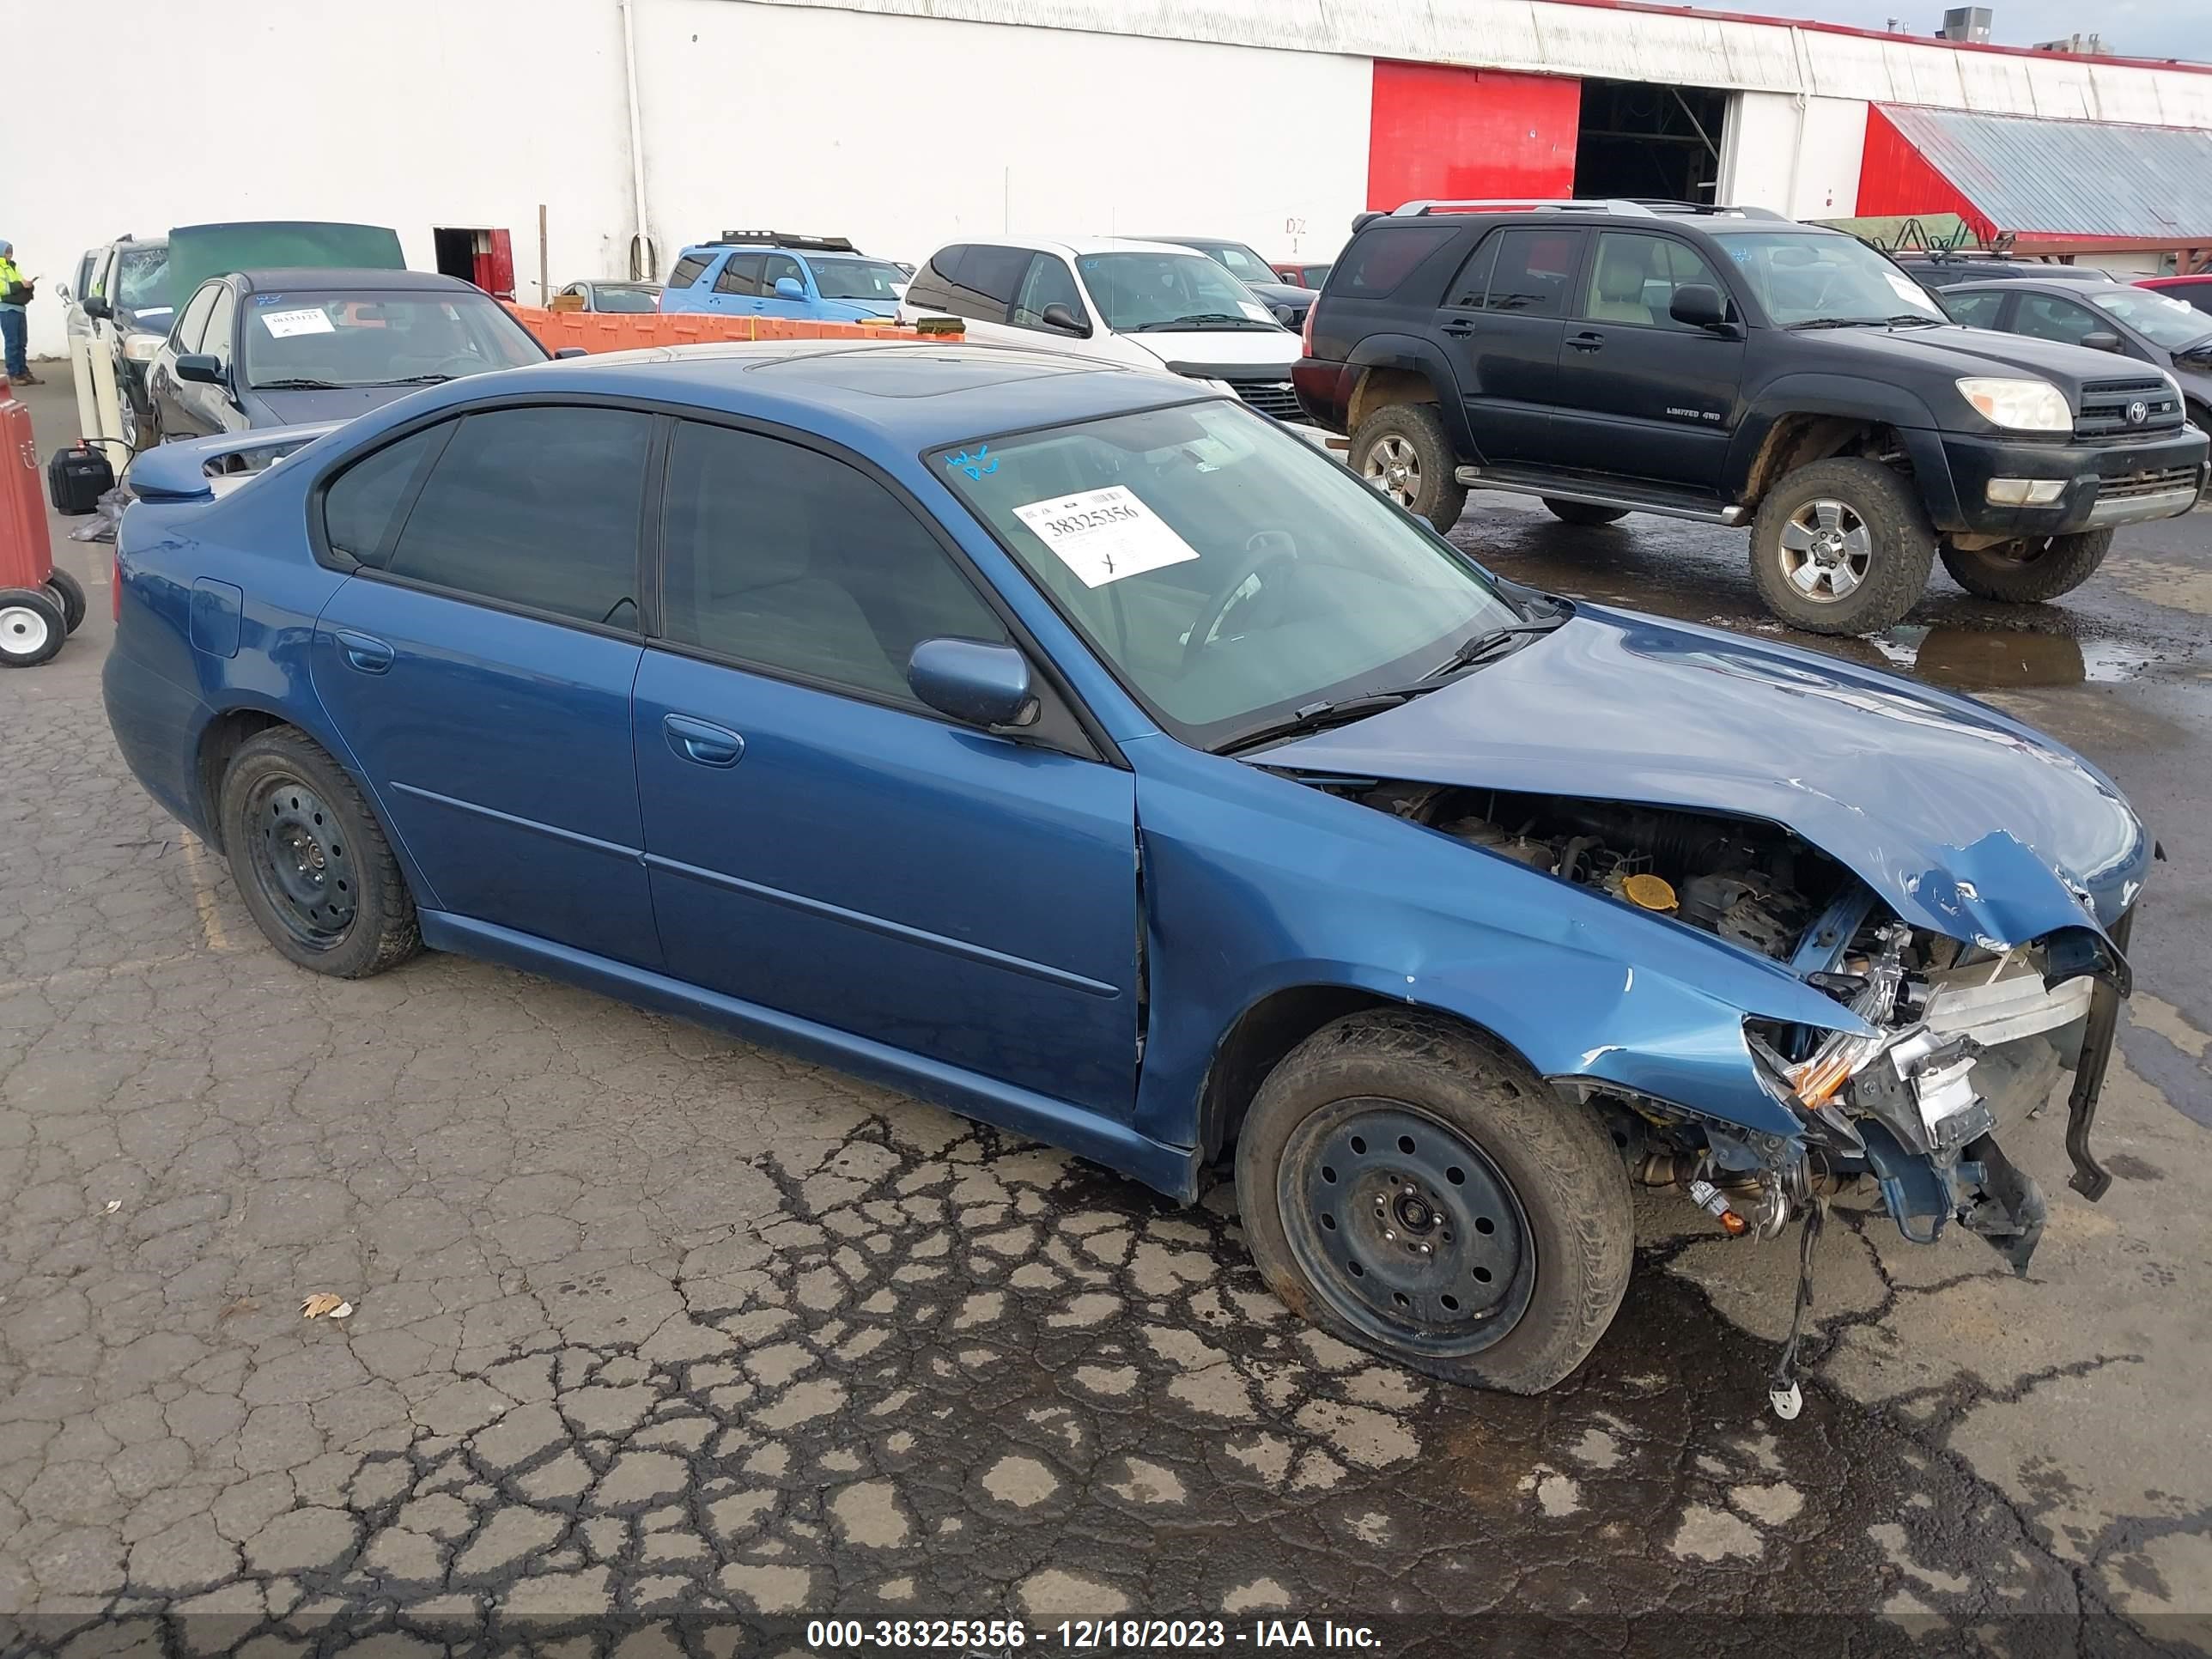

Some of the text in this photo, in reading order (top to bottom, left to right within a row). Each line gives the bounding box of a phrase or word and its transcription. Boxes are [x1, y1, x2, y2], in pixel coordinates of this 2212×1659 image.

[1667, 407, 1720, 421] LIMITED 4WD
[1045, 504, 1139, 537] 38325356
